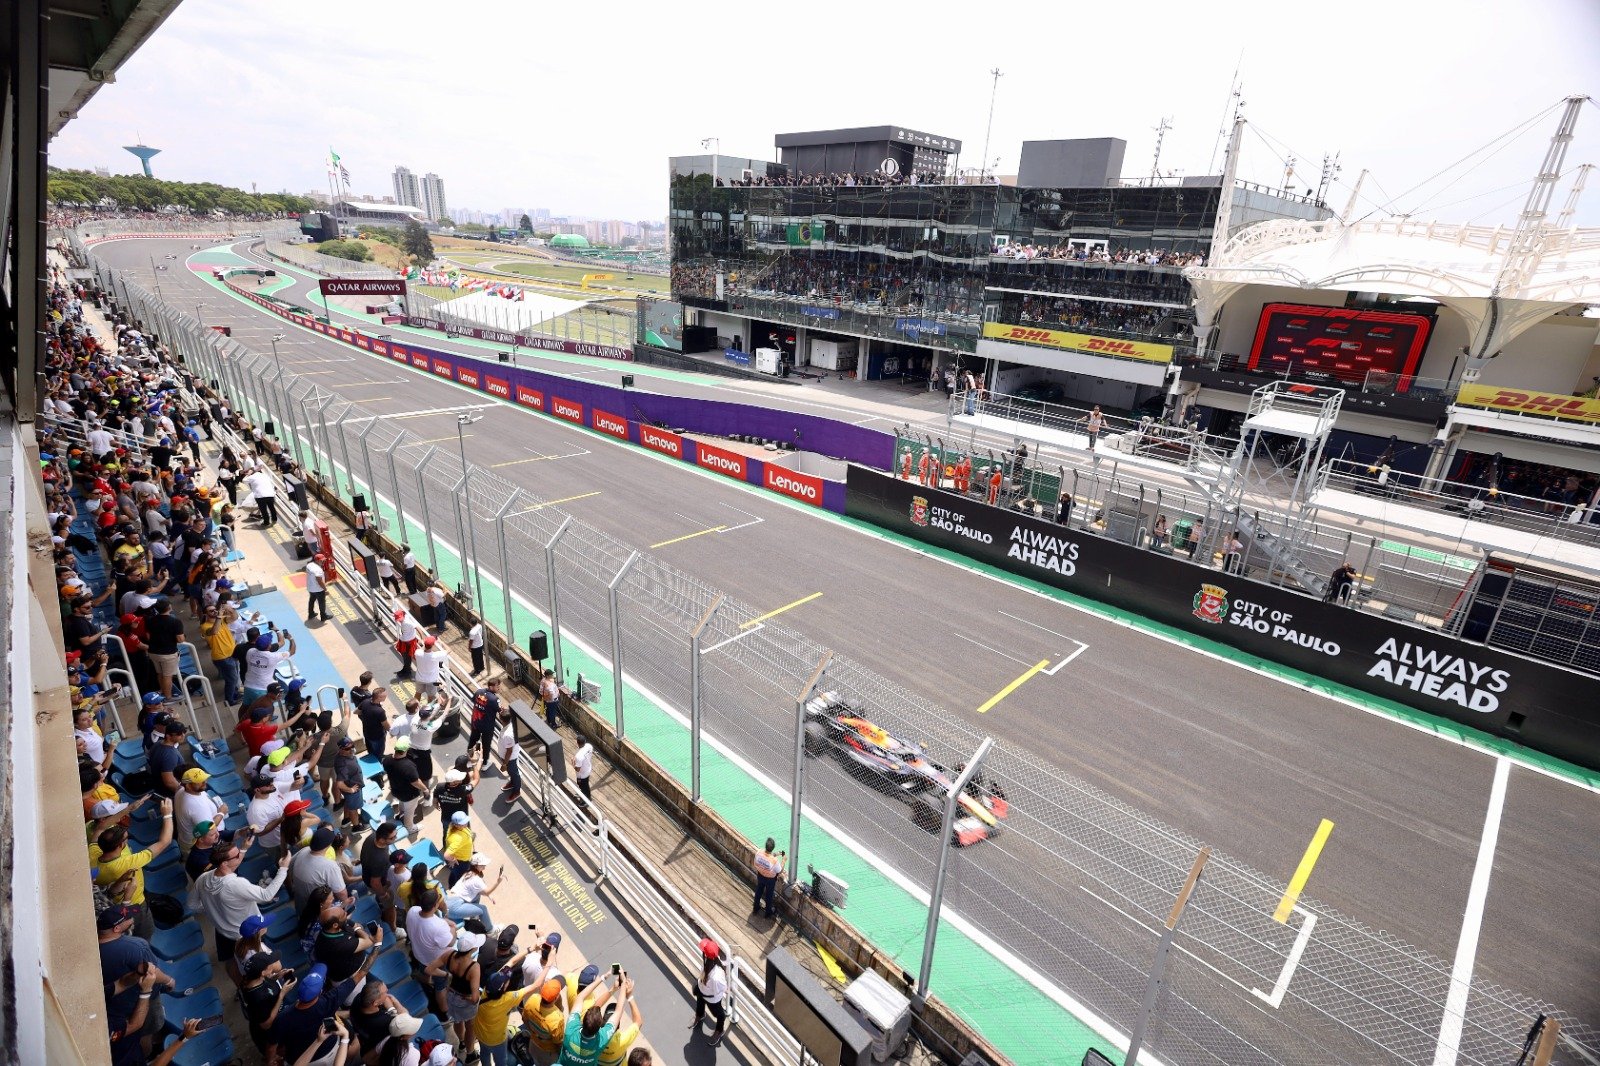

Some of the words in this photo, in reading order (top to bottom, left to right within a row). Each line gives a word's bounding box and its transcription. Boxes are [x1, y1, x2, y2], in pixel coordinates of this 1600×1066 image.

[328, 283, 360, 292] QATAR
[362, 283, 401, 292] AIRWAYS
[524, 336, 542, 348] QATAR
[543, 339, 565, 351] AIRWAYS
[1010, 327, 1052, 343] DHL
[575, 343, 597, 356] QATAR
[598, 345, 627, 360] AIRWAYS
[1086, 338, 1136, 356] DHL
[412, 355, 428, 368] Lenovo
[434, 363, 451, 376] Lenovo
[459, 370, 477, 385] Lenovo
[487, 380, 507, 395] Lenovo
[519, 390, 541, 406] Lenovo
[1491, 391, 1588, 416] DHL
[555, 402, 580, 420] Lenovo
[596, 415, 625, 435] Lenovo
[643, 430, 678, 453] Lenovo
[701, 449, 741, 474] Lenovo
[769, 470, 816, 499] Lenovo
[931, 506, 951, 518] CITY
[952, 512, 966, 523] OF
[931, 515, 953, 532] SÃO
[955, 525, 993, 545] PAULO
[1010, 525, 1079, 560] ALWAYS
[1007, 543, 1076, 577] AHEAD
[1233, 599, 1267, 618] CITY
[1270, 608, 1293, 624] OF
[1229, 611, 1269, 635] SÃO
[1273, 626, 1341, 656] PAULO
[1374, 637, 1511, 693] ALWAYS
[1366, 659, 1499, 713] AHEAD
[530, 861, 546, 876] EM
[538, 871, 557, 885] PÉ
[546, 882, 571, 908] NESTE
[590, 909, 607, 925] DE
